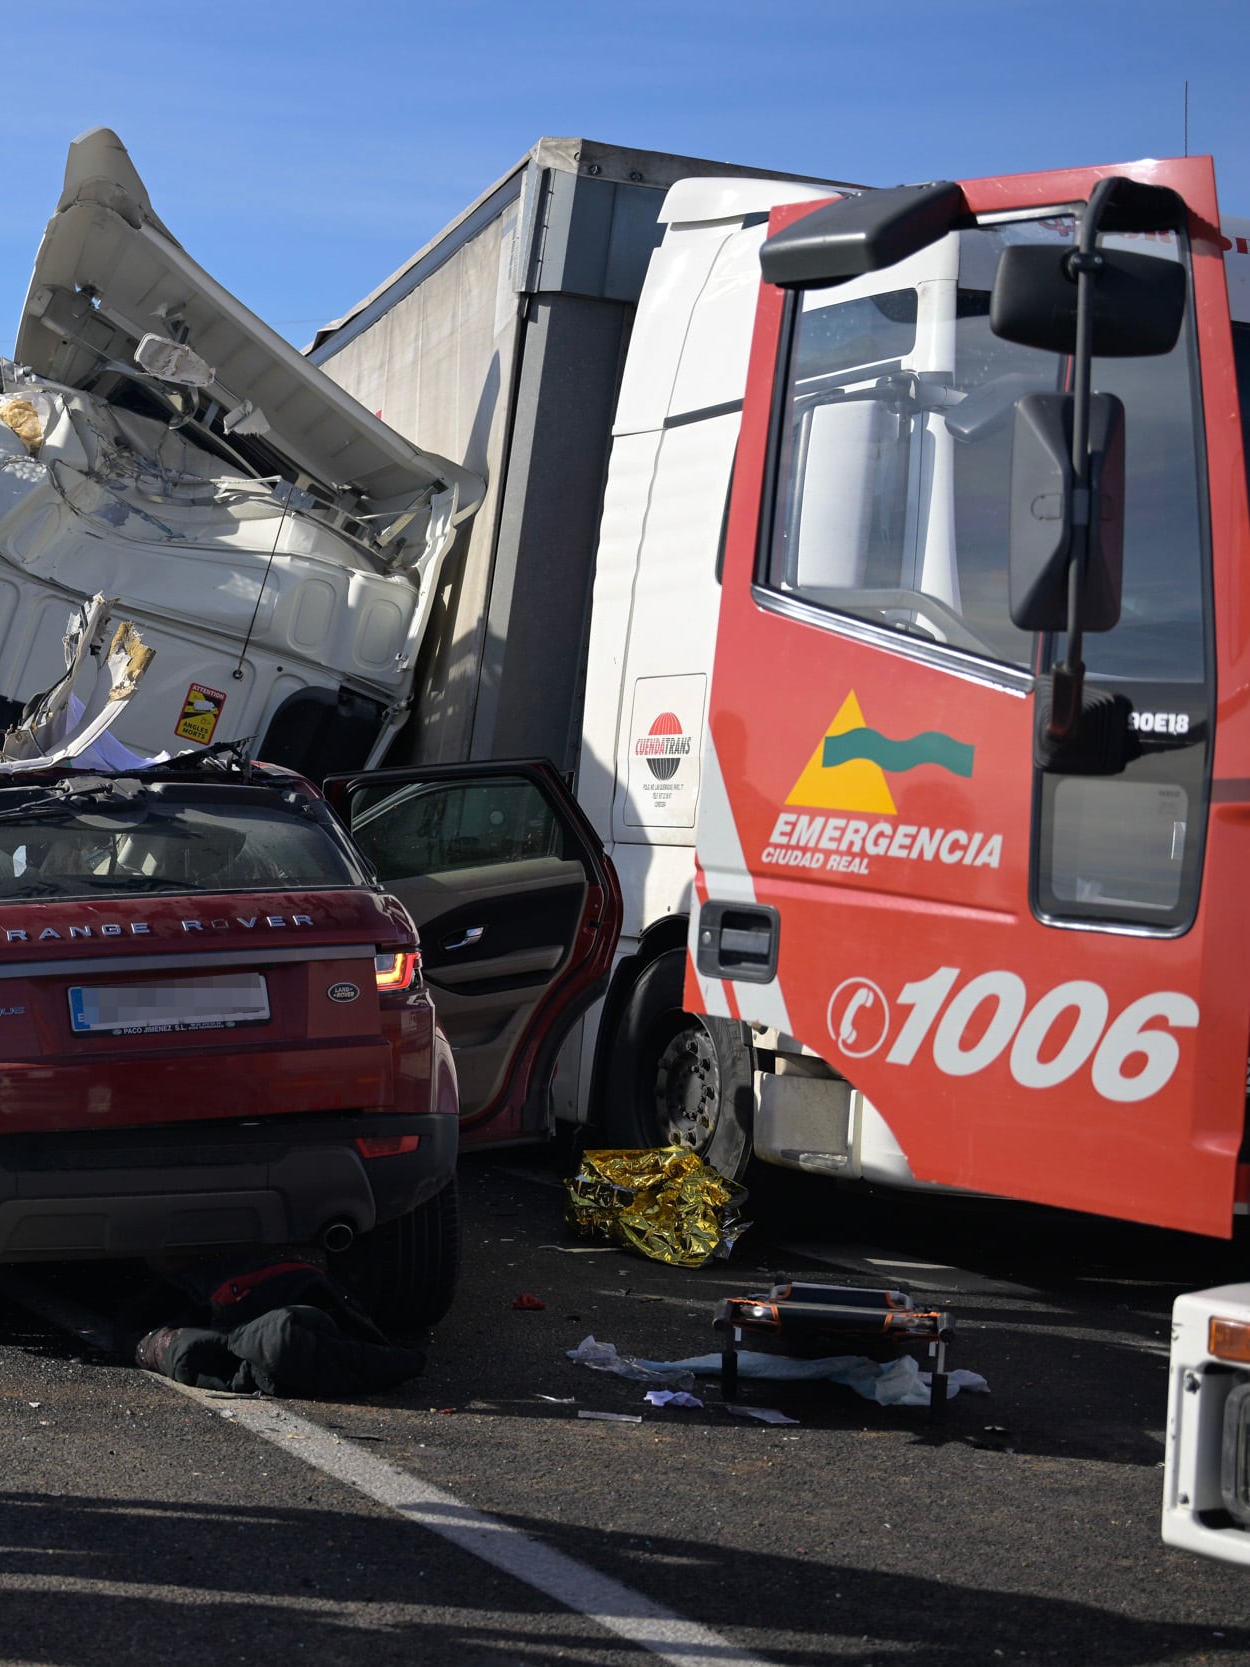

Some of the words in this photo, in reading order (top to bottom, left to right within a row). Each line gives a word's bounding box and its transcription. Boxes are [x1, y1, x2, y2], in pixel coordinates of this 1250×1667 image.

[192, 685, 225, 698] ATTENTION
[182, 727, 206, 739] MORTS
[184, 721, 208, 734] ANGLES
[769, 812, 1004, 869] EMERGENCIA
[761, 847, 825, 868] CIUDAD
[826, 854, 870, 875] REAL
[6, 922, 150, 941] RANGE
[181, 914, 314, 932] ROVER
[123, 1026, 143, 1034] PACO
[885, 966, 1200, 1103] 1006
